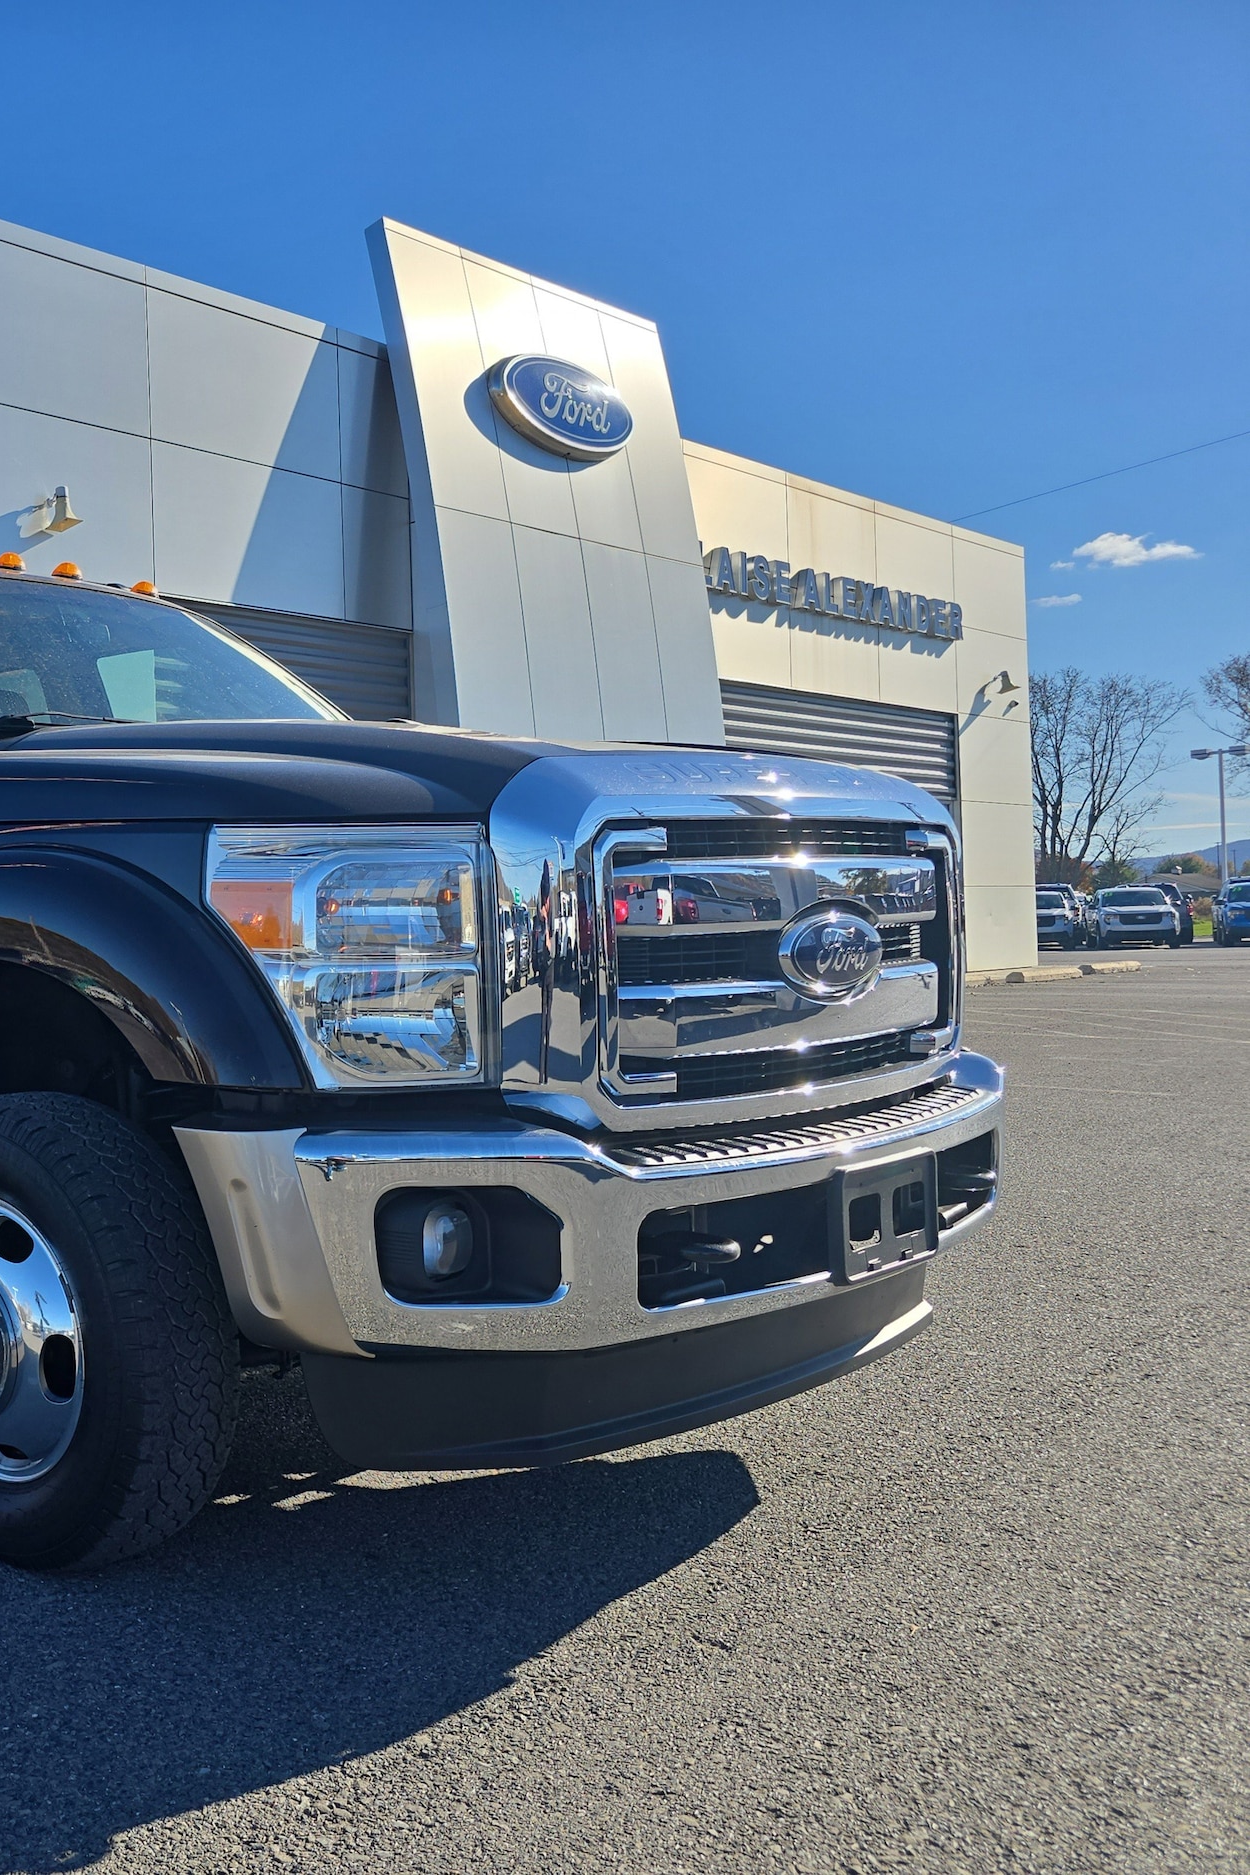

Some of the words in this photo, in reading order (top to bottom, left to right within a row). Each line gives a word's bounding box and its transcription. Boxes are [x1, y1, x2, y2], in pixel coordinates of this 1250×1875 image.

[540, 372, 611, 434] Ford
[798, 568, 963, 640] ALEXANDER
[816, 927, 869, 974] Ford
